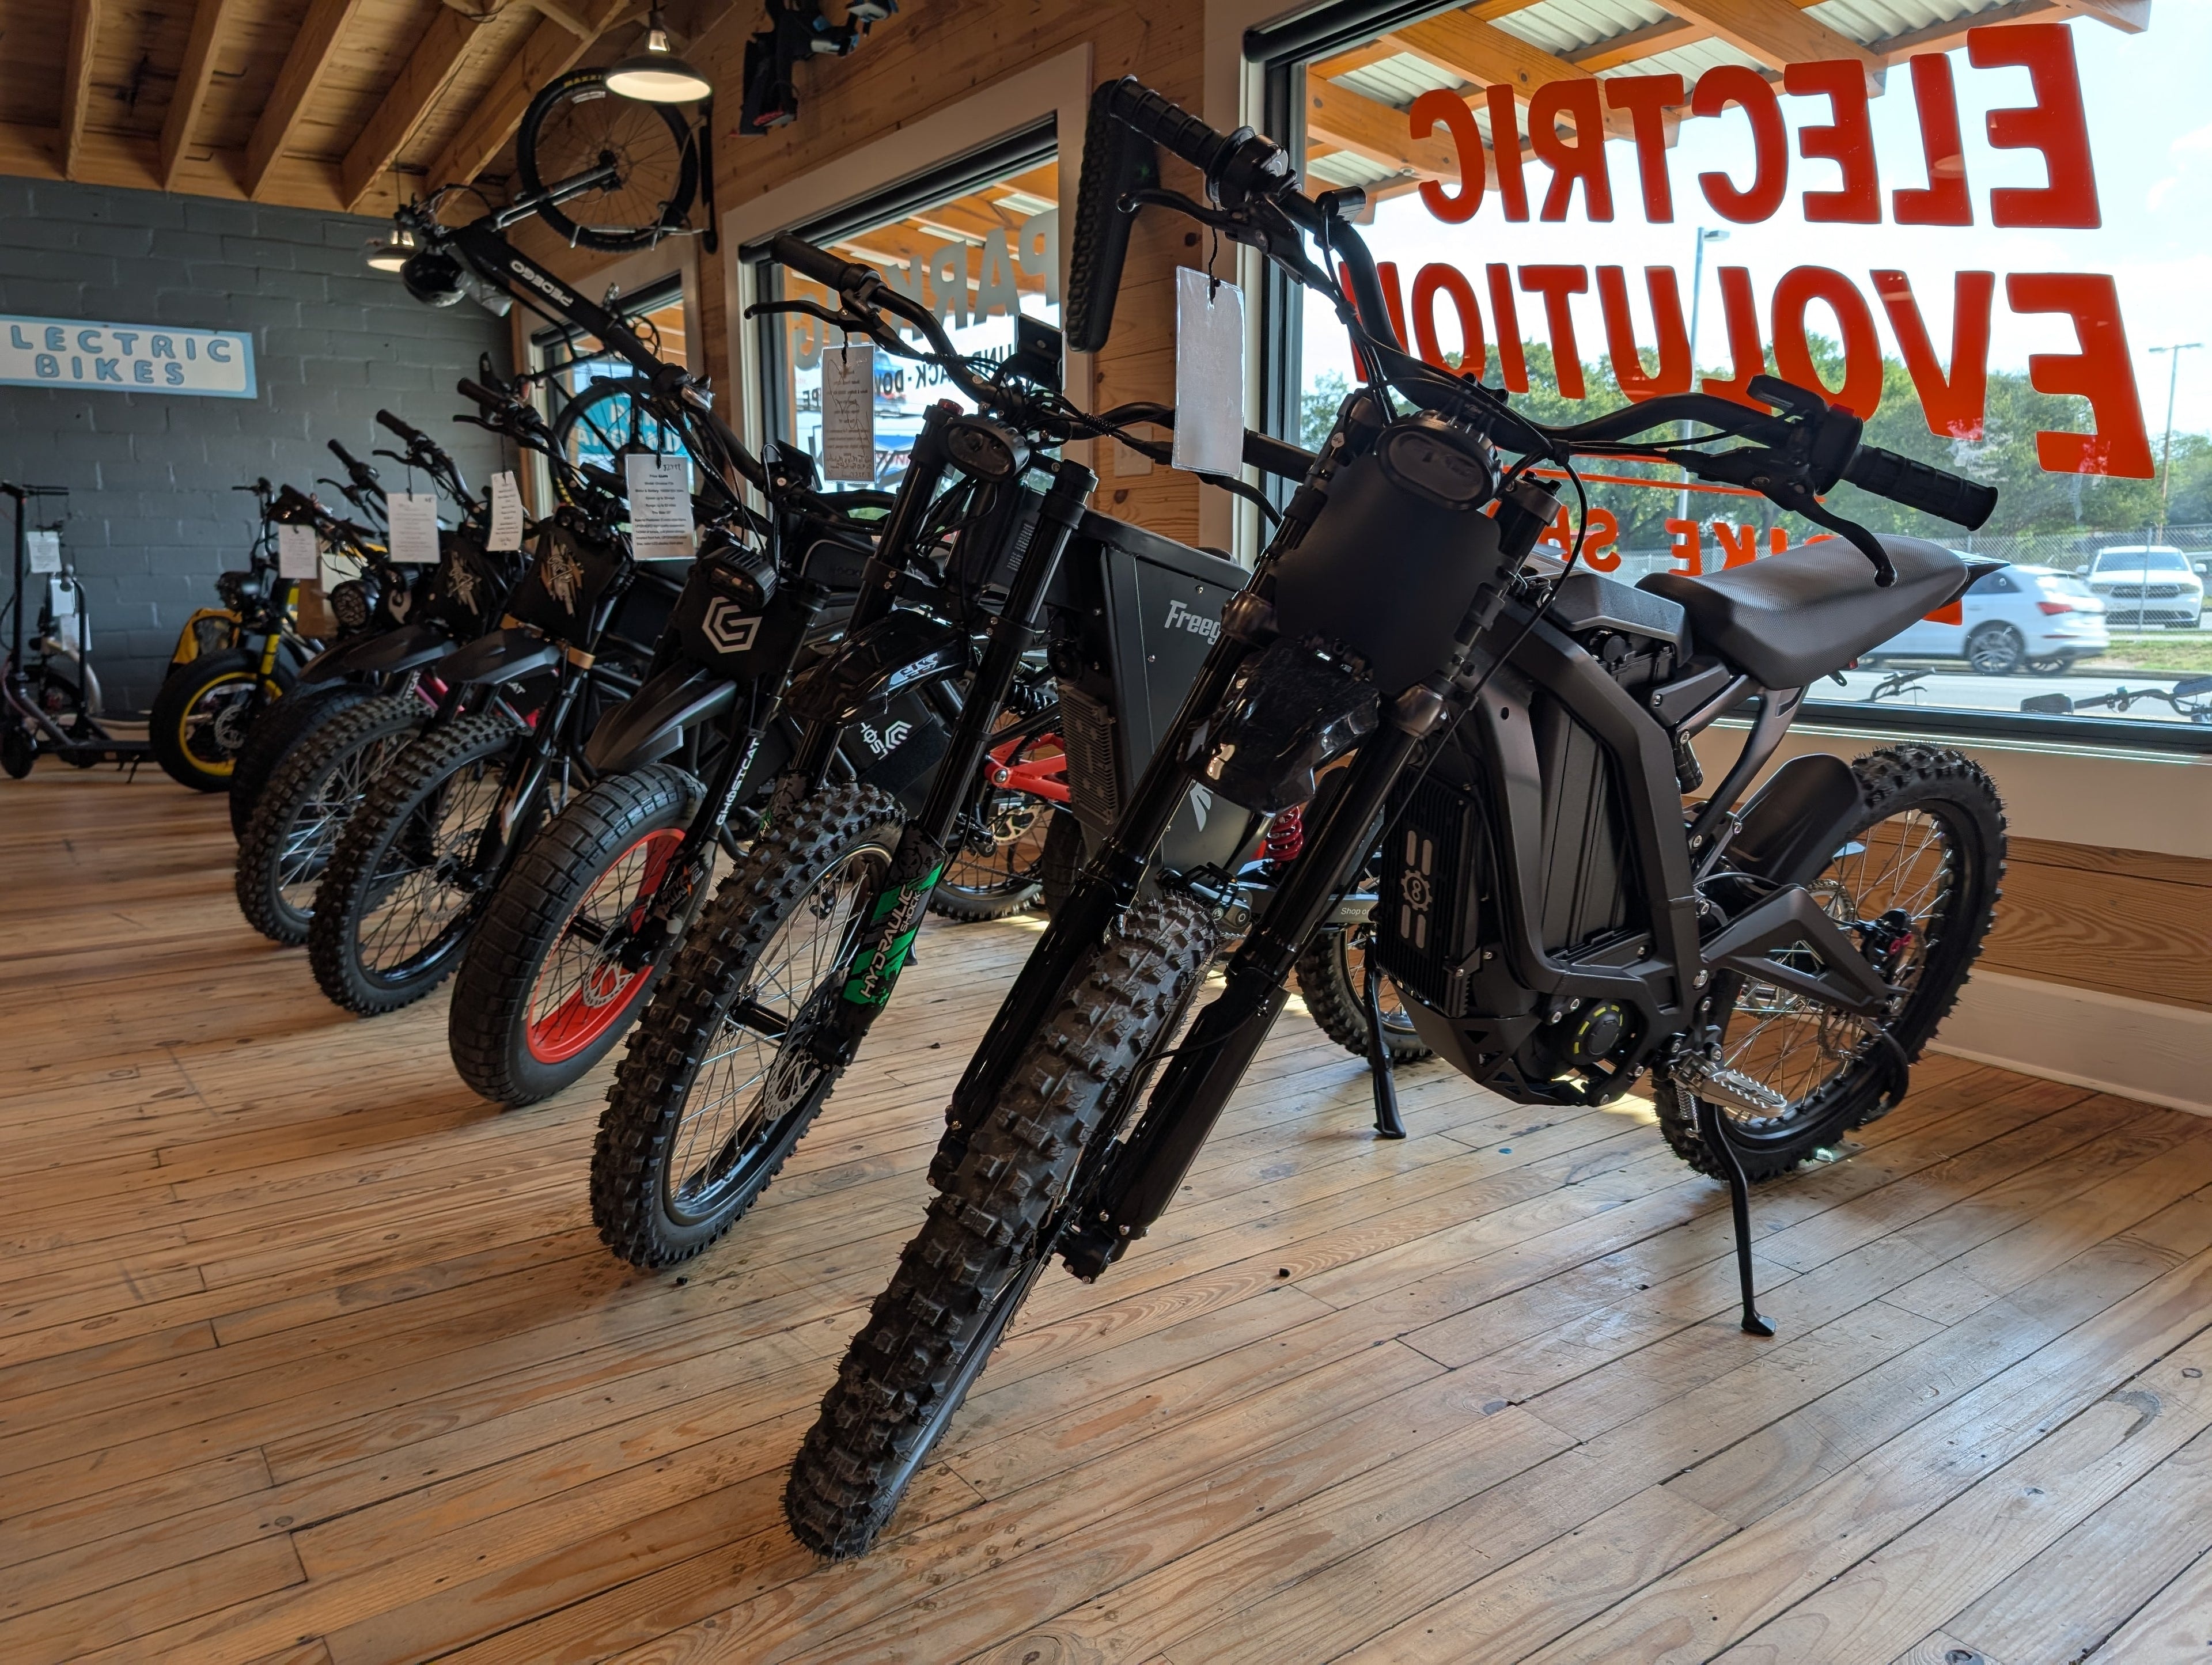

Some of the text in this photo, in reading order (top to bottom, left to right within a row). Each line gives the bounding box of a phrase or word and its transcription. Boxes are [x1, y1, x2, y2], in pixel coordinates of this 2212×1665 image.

[511, 260, 574, 307] PEDEGO
[10, 324, 231, 363] LECTRIC
[36, 352, 185, 386] BIKES
[1164, 600, 1221, 645] Freeg
[900, 891, 922, 932] SHOCK
[1341, 908, 1361, 916] Shop
[860, 884, 913, 998] HYDRAULIC
